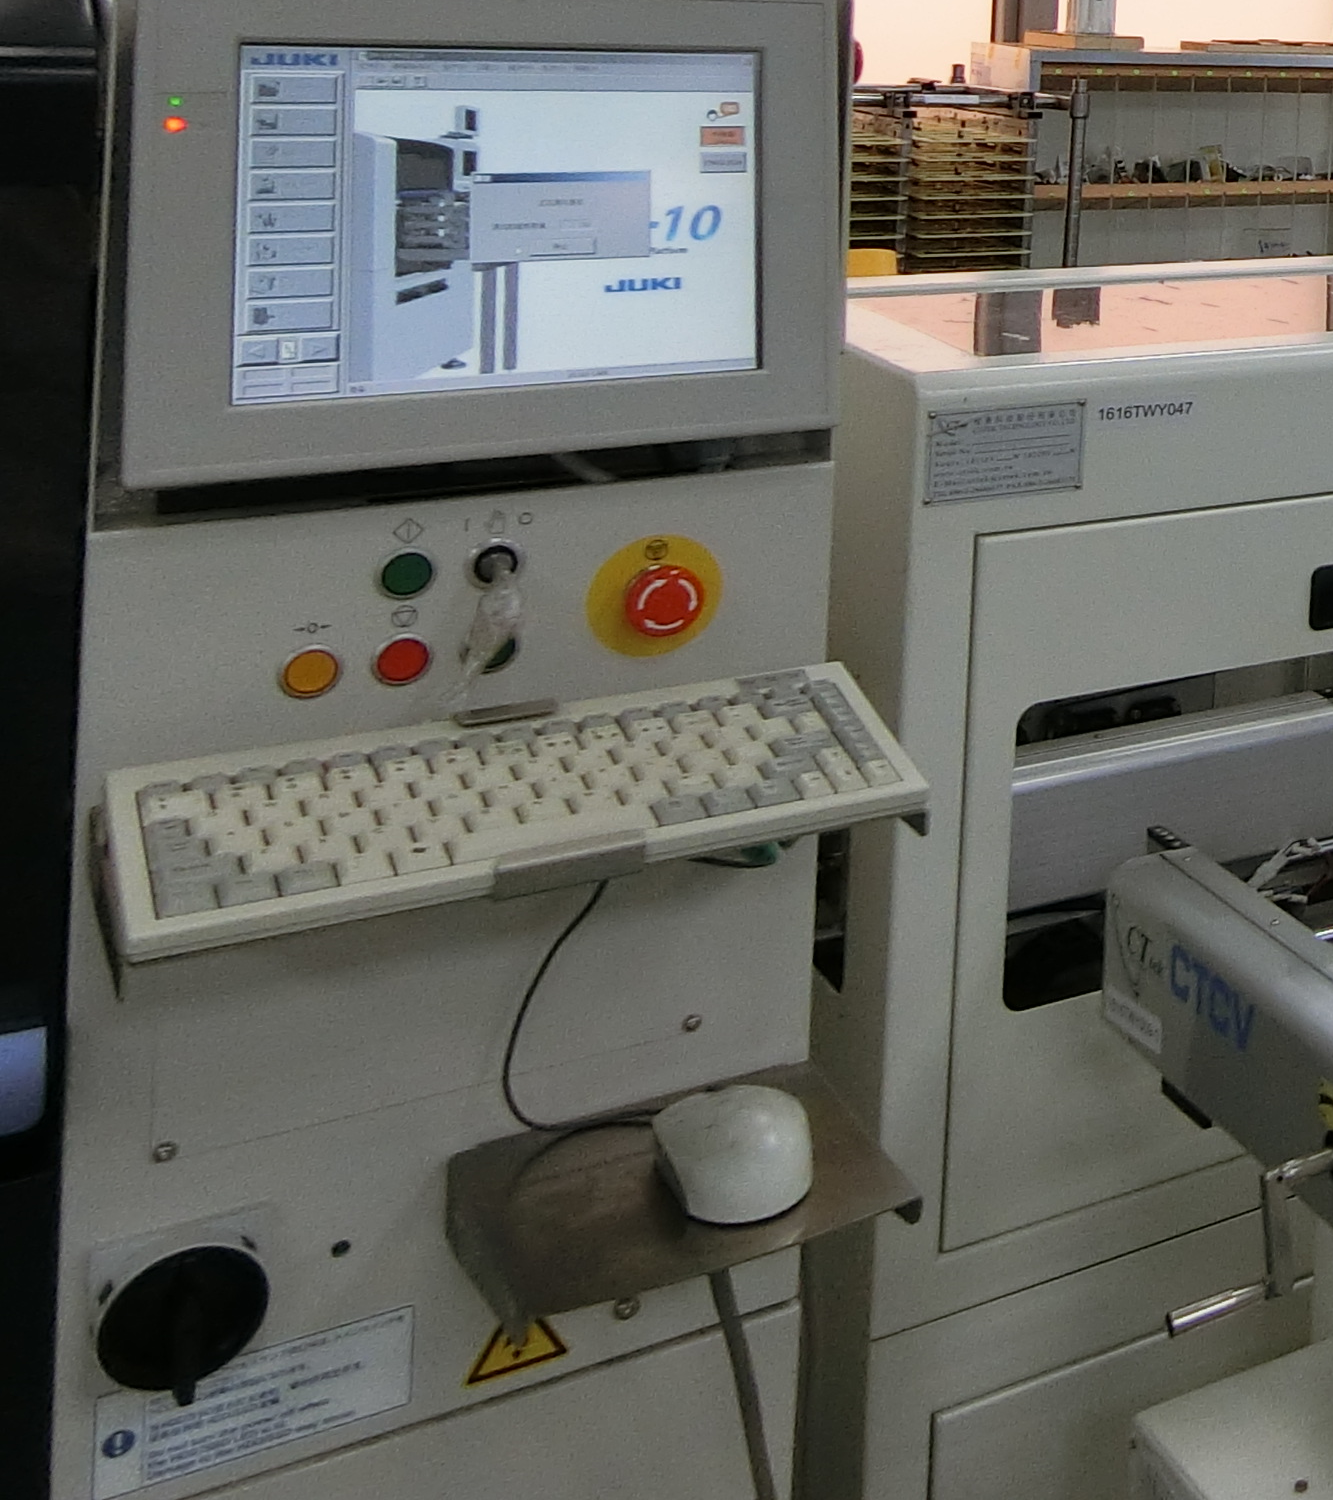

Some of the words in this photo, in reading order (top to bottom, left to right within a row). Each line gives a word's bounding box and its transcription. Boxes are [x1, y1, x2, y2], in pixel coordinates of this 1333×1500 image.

[250, 52, 339, 67] JUKI
[604, 276, 682, 293] JUKI
[1098, 401, 1194, 422] 1616TWY047
